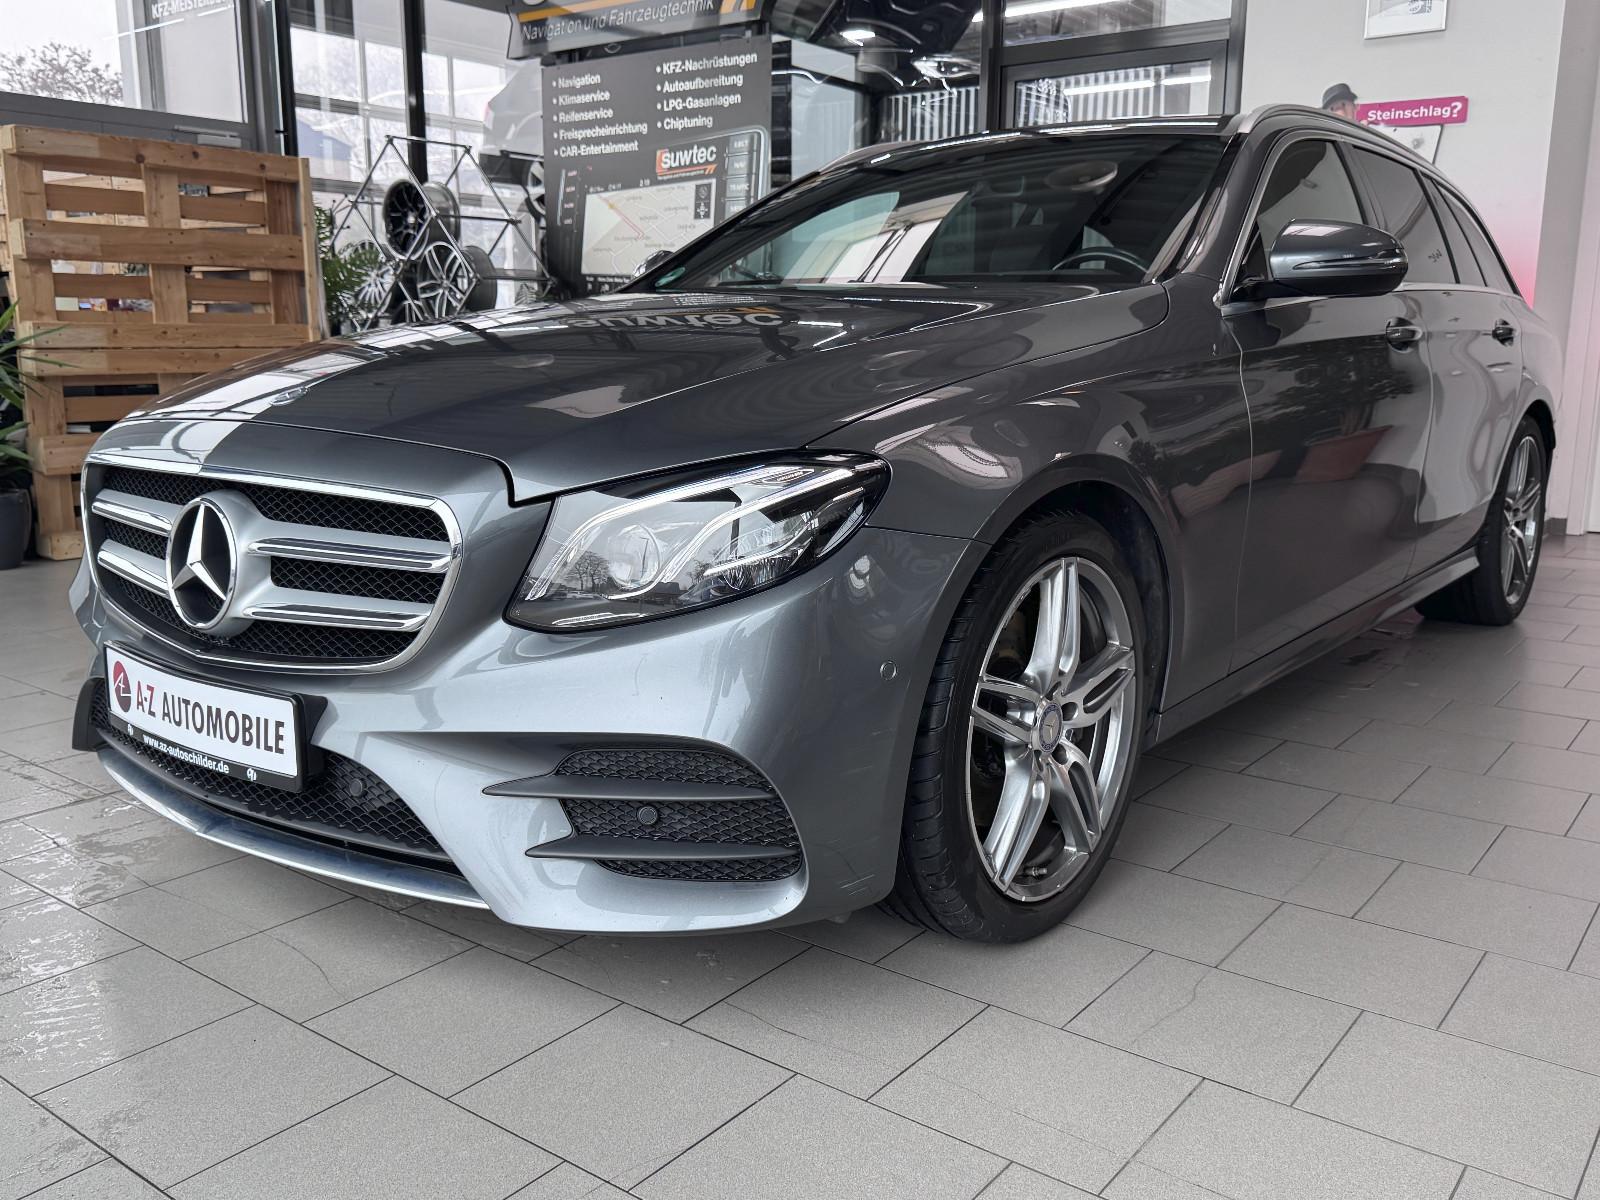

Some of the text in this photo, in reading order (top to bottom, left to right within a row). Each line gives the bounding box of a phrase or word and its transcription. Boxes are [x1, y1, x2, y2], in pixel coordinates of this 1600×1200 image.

[522, 0, 714, 41] Navigation und Fahrzeugtechnik
[663, 53, 757, 74] KFZ-Nachrüstungen
[558, 73, 601, 88] Navigation
[663, 74, 743, 93] Autoaufbereitung
[559, 90, 610, 106] Klimaservice
[663, 94, 741, 111] LPG-Gasanlagen
[559, 108, 613, 123] Reifenservice
[1367, 102, 1462, 121] Steinschlag?
[560, 122, 648, 140] Freisprecheinrichtung
[664, 115, 713, 131] Chiptuning
[560, 140, 639, 157] CAR-Entertainment
[661, 144, 717, 169] suwtec
[136, 680, 285, 755] A-Z AUTOMOBILE
[143, 733, 230, 774] www.az-autoschilder.de
